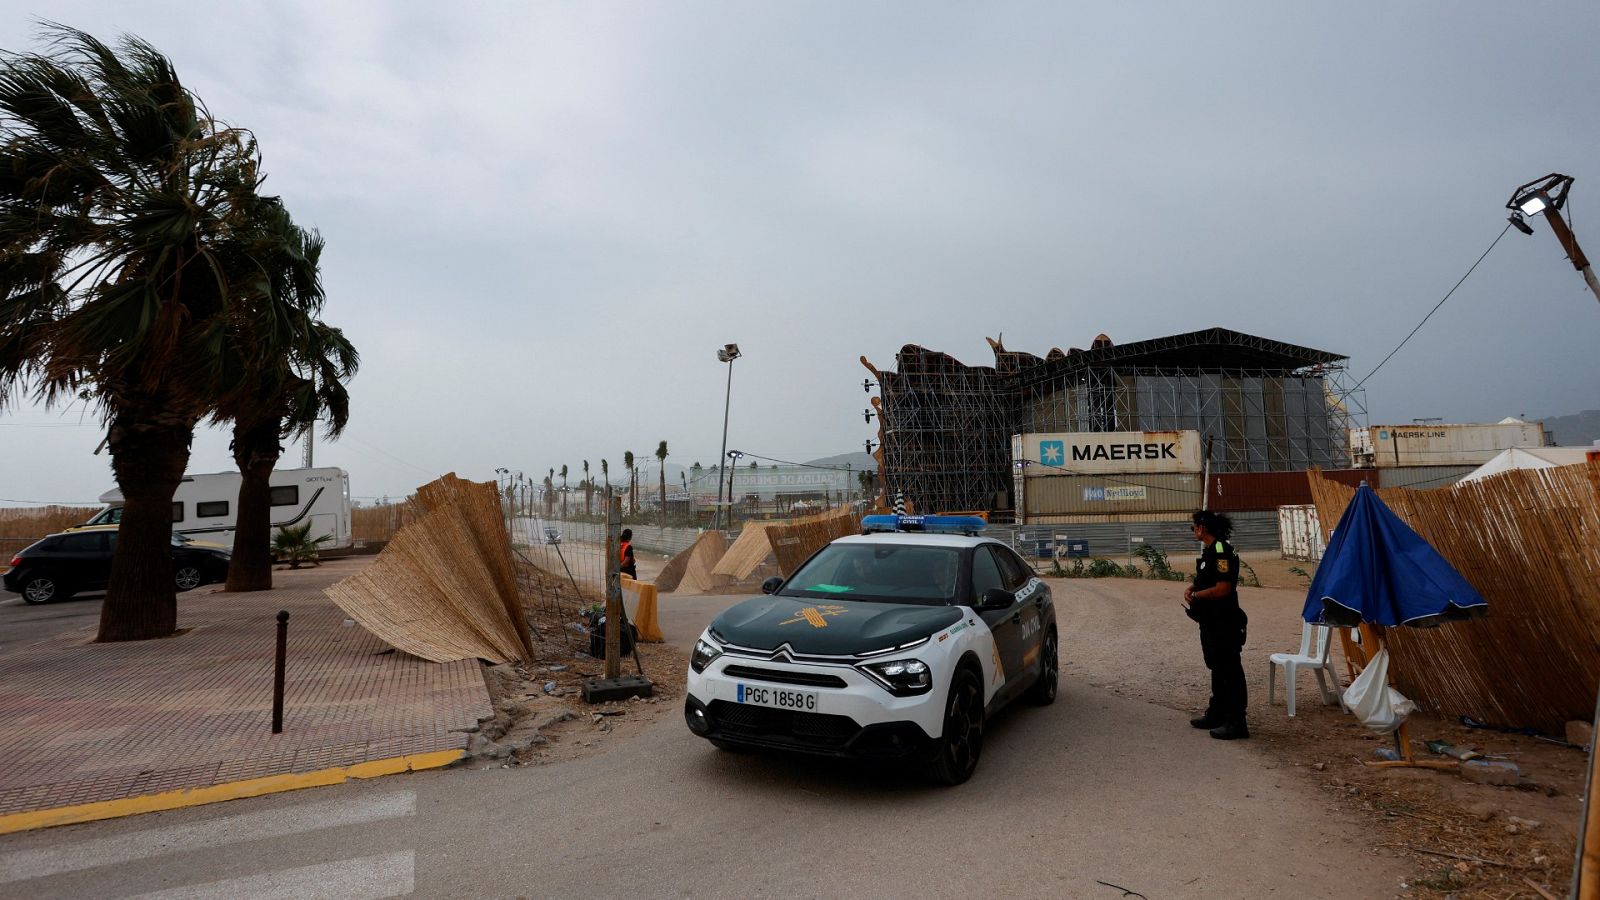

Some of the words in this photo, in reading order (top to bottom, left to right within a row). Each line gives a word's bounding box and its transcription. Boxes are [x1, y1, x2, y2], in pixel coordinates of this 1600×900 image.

[1072, 442, 1177, 461] MAERSK
[745, 687, 769, 704] PGC
[772, 690, 804, 708] 1858
[806, 694, 815, 710] G
